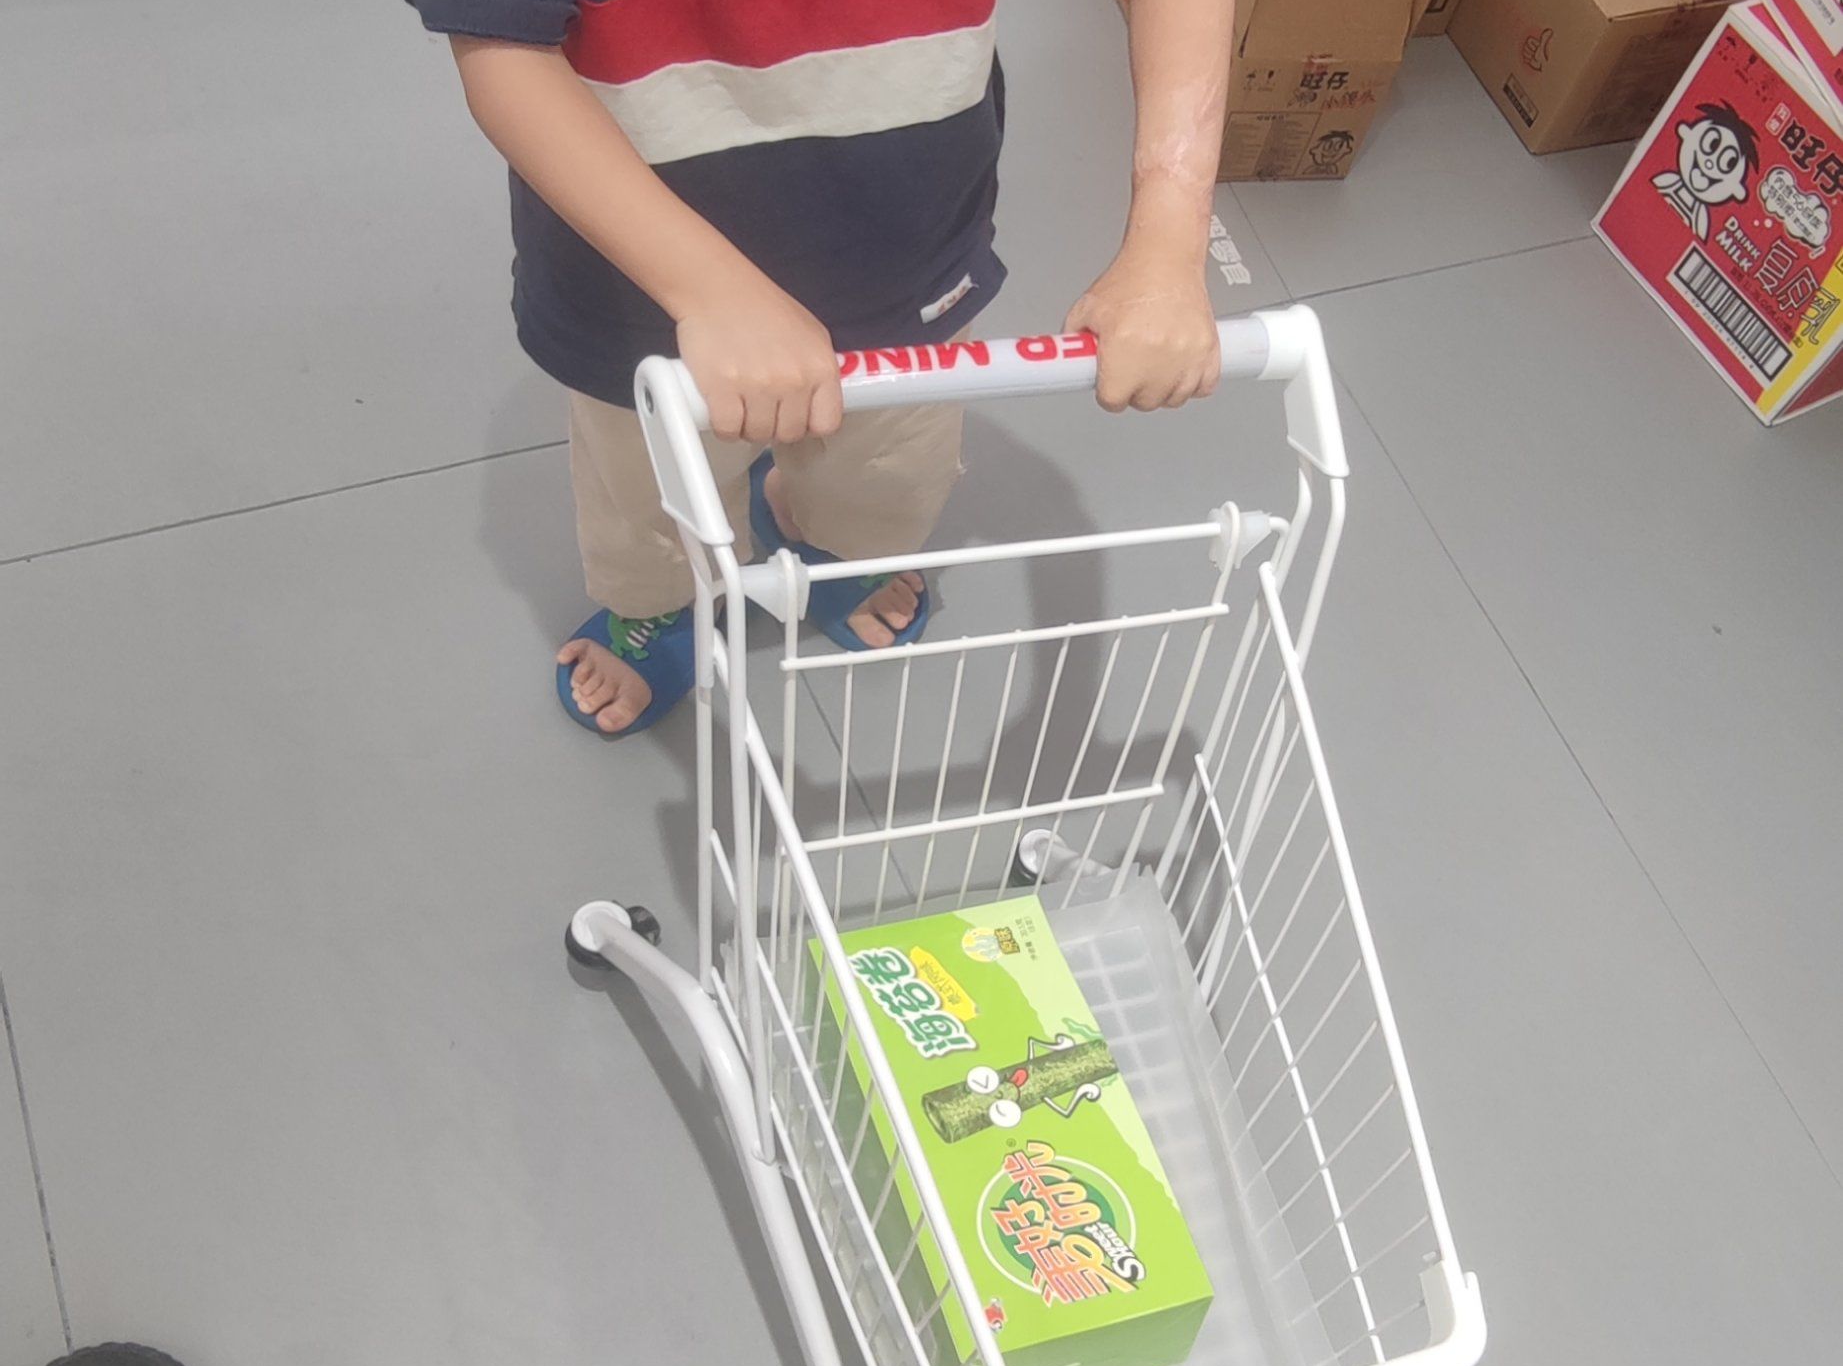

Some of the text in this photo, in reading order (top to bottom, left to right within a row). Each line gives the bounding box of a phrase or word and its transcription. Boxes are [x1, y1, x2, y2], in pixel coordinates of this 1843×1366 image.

[1781, 119, 1843, 198] 旺仔
[1715, 232, 1753, 272] MILK
[1724, 217, 1762, 260] DRINK
[850, 948, 976, 1057] 海苔卷
[991, 1140, 1139, 1306] 美好时光
